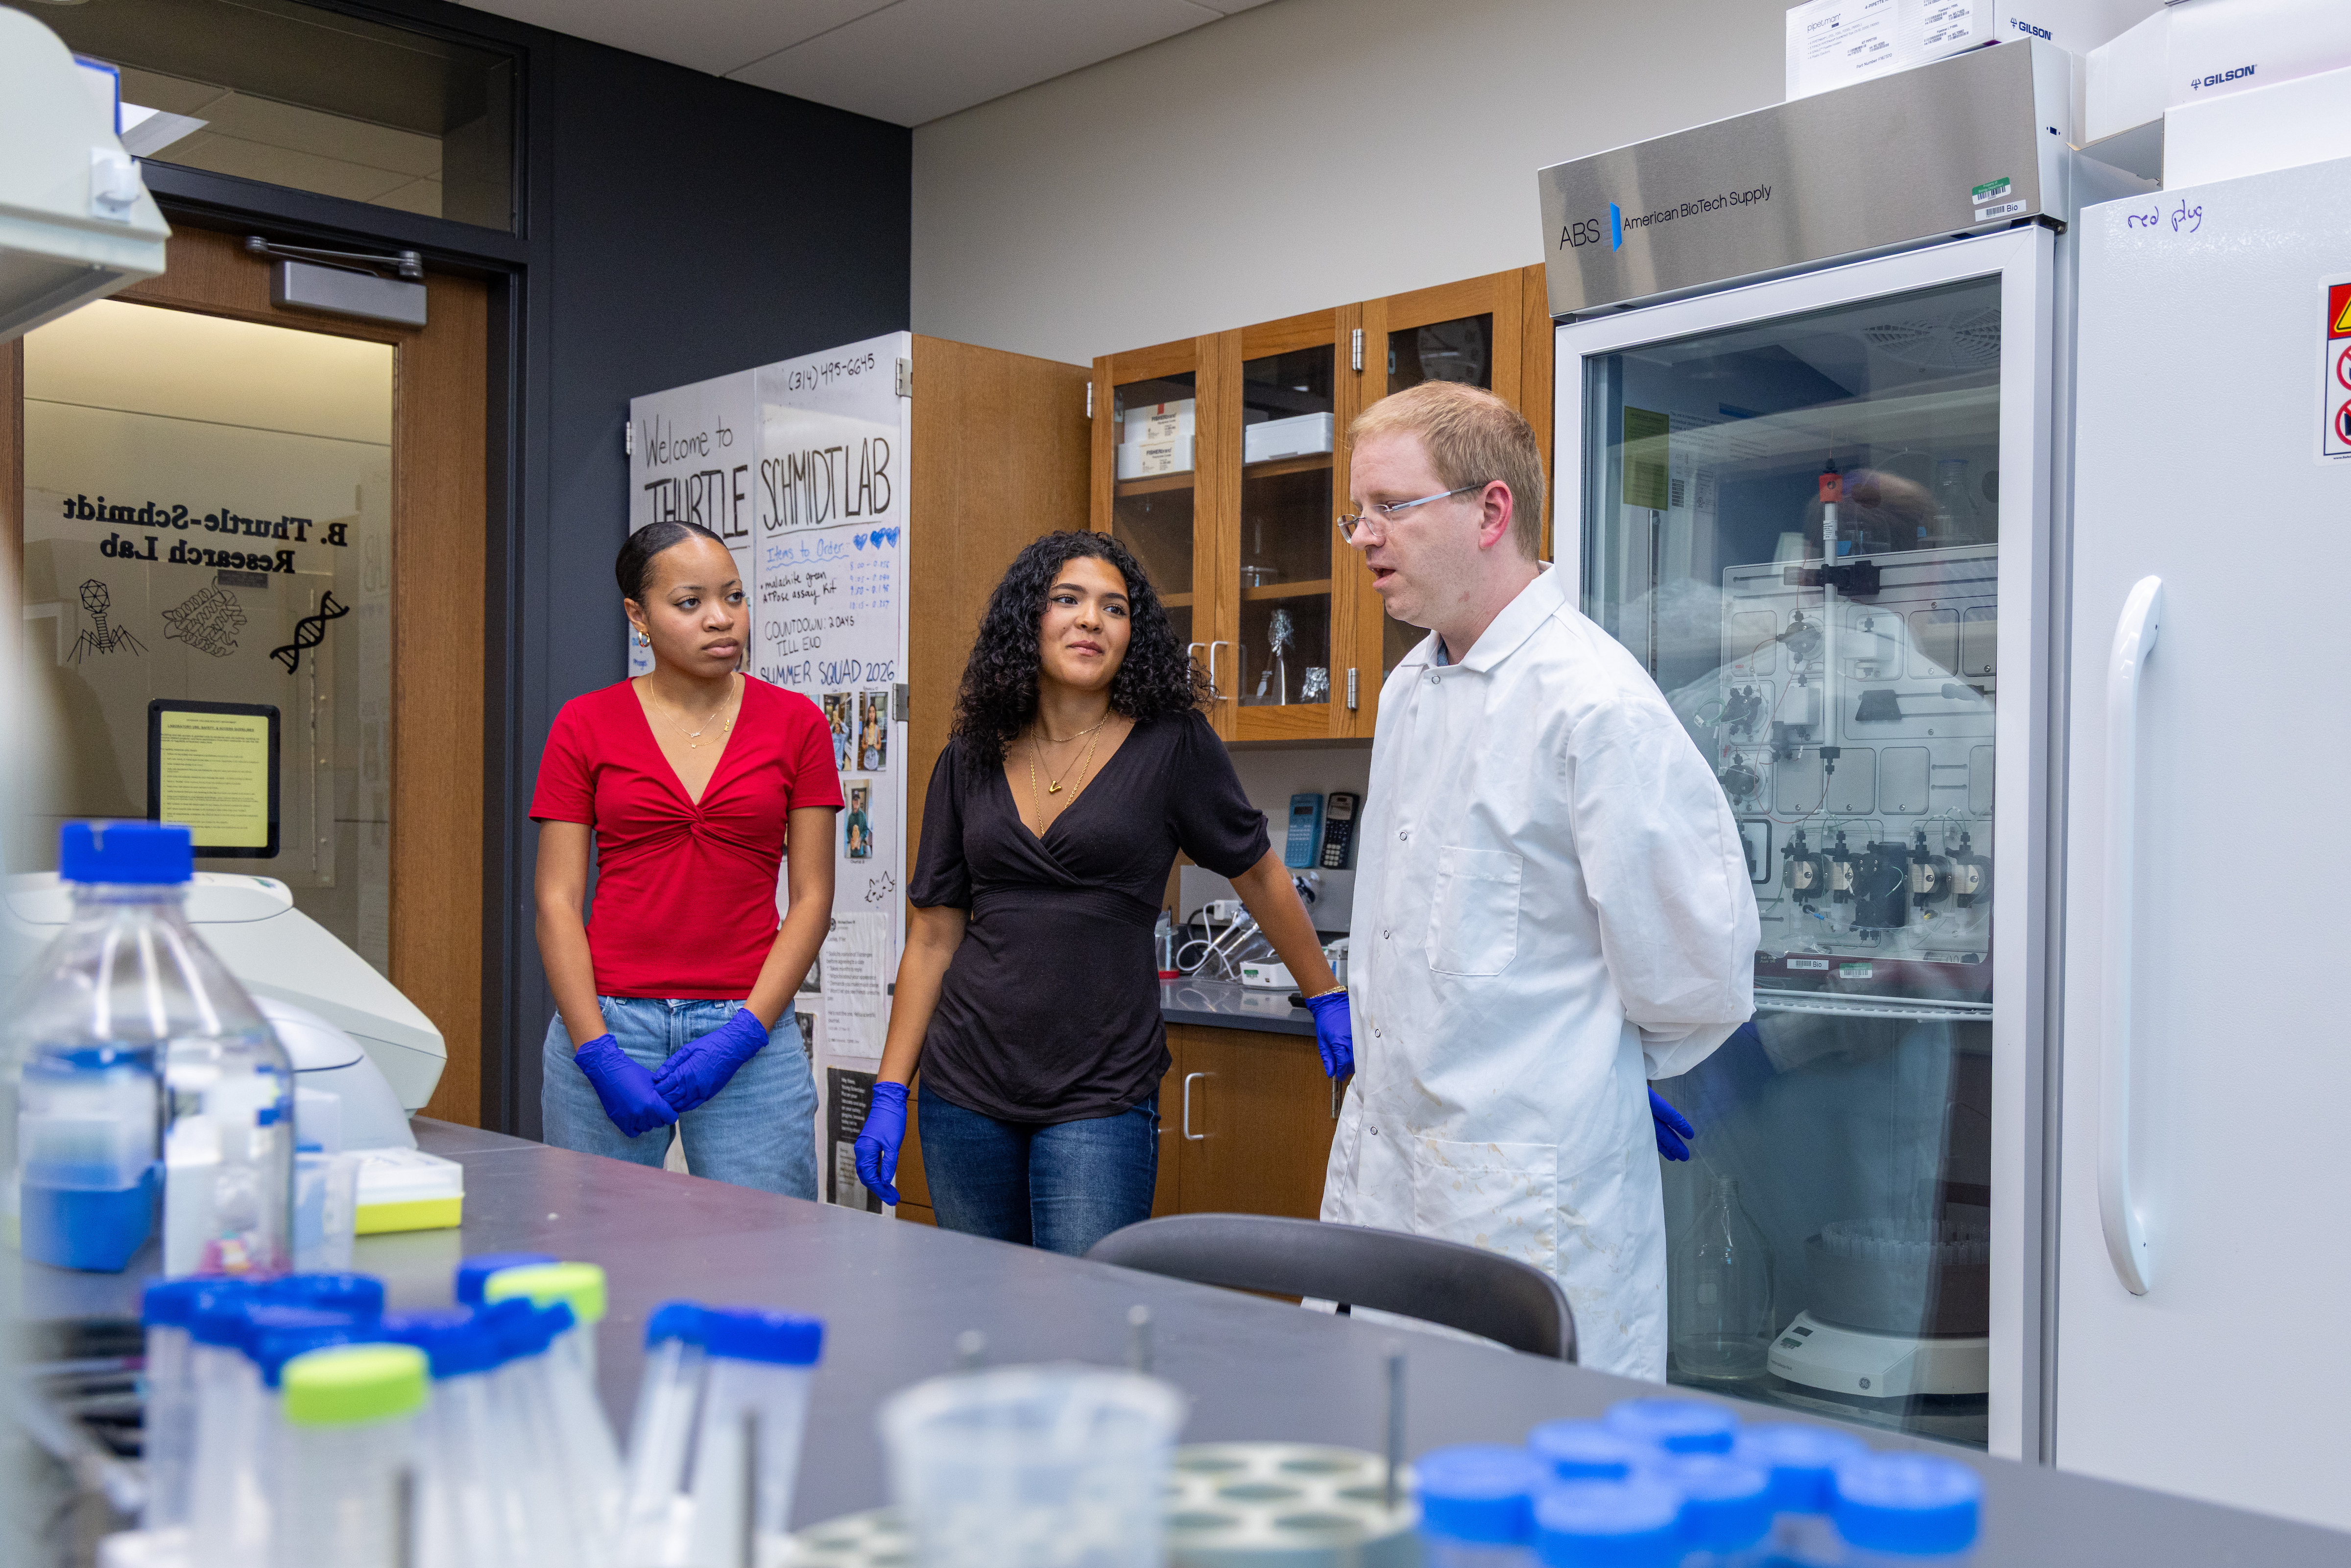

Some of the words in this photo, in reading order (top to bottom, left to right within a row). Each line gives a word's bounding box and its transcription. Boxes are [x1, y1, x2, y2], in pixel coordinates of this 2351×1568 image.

[2019, 21, 2051, 41] GILSON
[1878, 53, 1892, 61] F167370
[2204, 65, 2255, 87] GILSON
[1624, 207, 1679, 231] American
[1680, 194, 1727, 218] BioTech
[1729, 184, 1772, 207] Supply
[2128, 206, 2159, 229] red
[2171, 199, 2202, 233] plug
[1559, 218, 1601, 250] ABS
[789, 365, 817, 391] (314)
[821, 353, 875, 384] 495-6645
[643, 414, 710, 469] Welcome
[716, 415, 733, 447] to
[645, 465, 748, 539] THURTLE
[761, 446, 842, 531] SCHMIDT
[845, 437, 891, 516] LAB
[767, 546, 794, 563] Items
[800, 540, 810, 558] to
[765, 570, 801, 588] malachite
[806, 570, 827, 588] green
[763, 591, 789, 603] ATPase
[792, 590, 820, 605] assay
[765, 617, 826, 641] COUNTDOWN:
[829, 617, 834, 628] 2
[836, 616, 855, 628] DAYS
[776, 640, 799, 657] TILL
[802, 636, 822, 651] END
[760, 660, 812, 686] SUMMER
[818, 659, 862, 686] SQUAD
[866, 660, 895, 683] 2026
